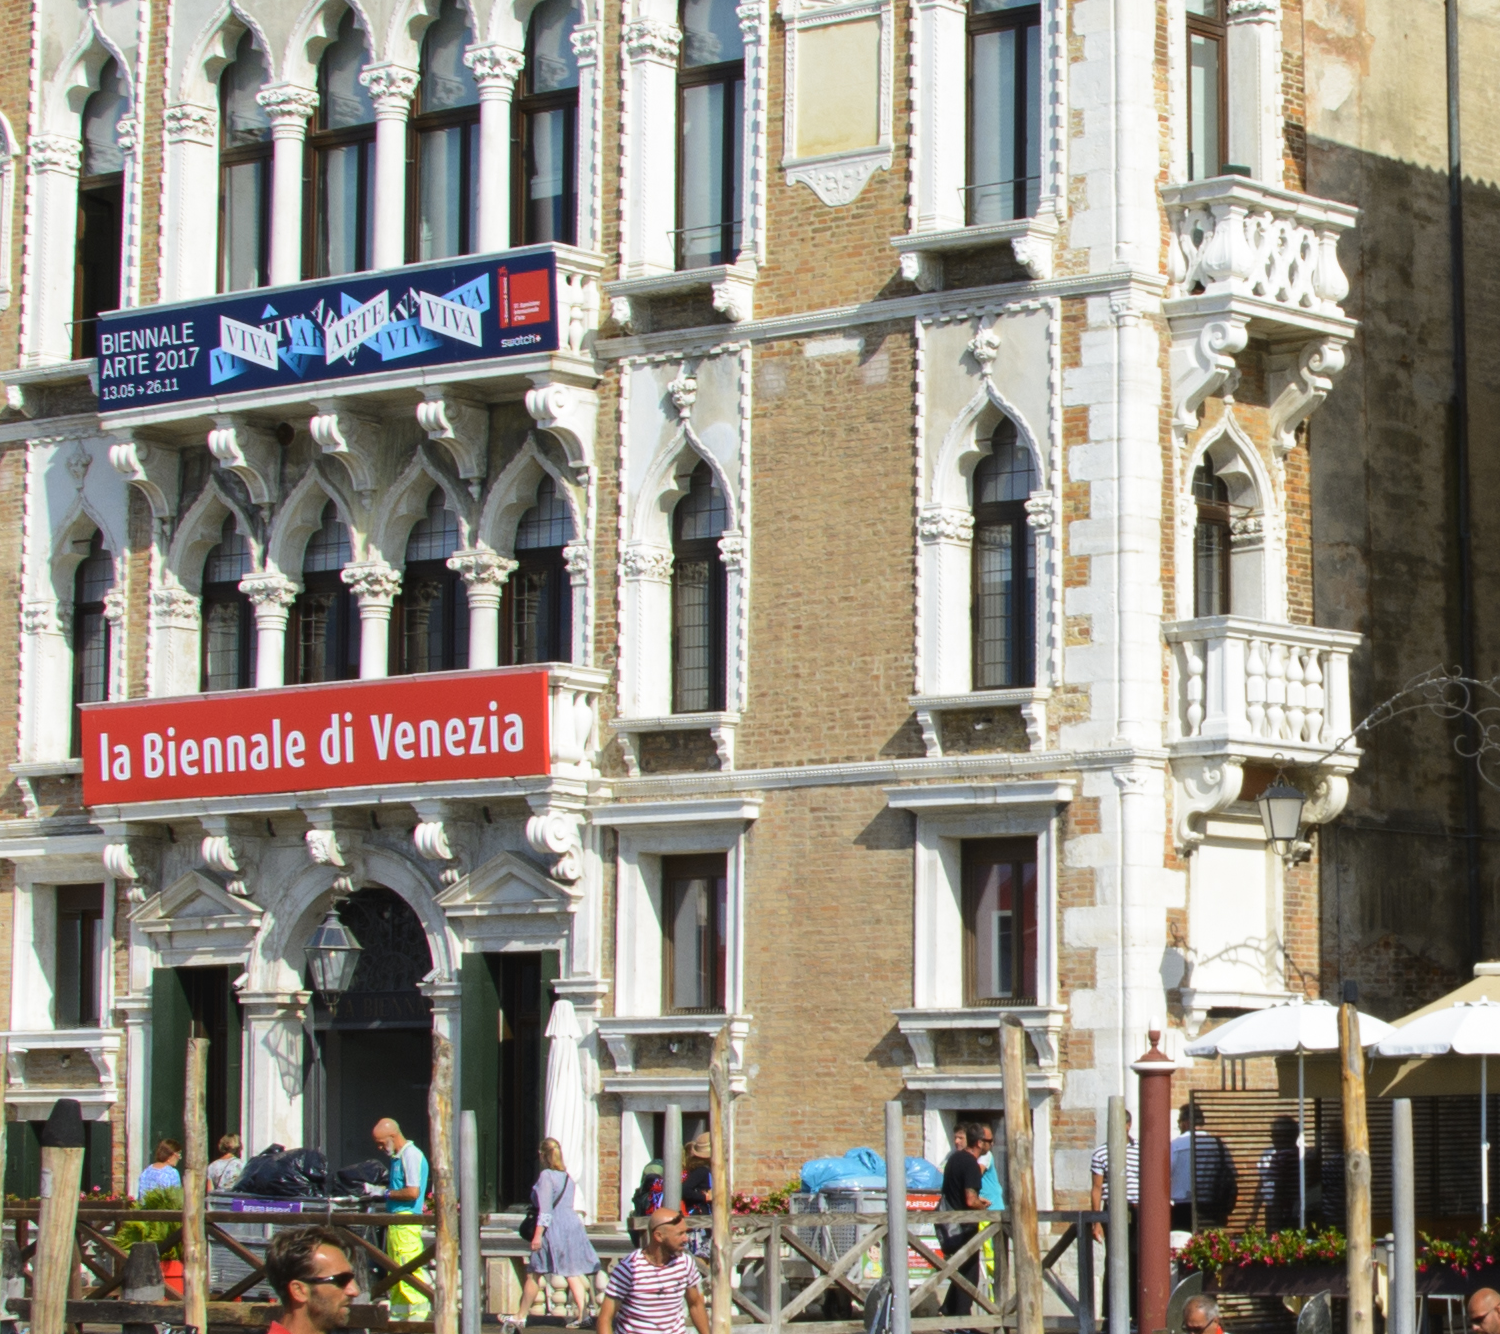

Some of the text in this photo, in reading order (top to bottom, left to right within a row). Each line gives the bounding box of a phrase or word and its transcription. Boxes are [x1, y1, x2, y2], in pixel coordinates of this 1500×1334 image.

[101, 322, 195, 355] BIENNALE
[330, 299, 386, 357] ARTE
[425, 299, 477, 339] VIVA
[102, 347, 200, 379] ARTE 2017
[225, 323, 274, 363] VIVA
[102, 377, 180, 401] 13.05 26.11
[100, 700, 524, 781] la Biennale di Venezia
